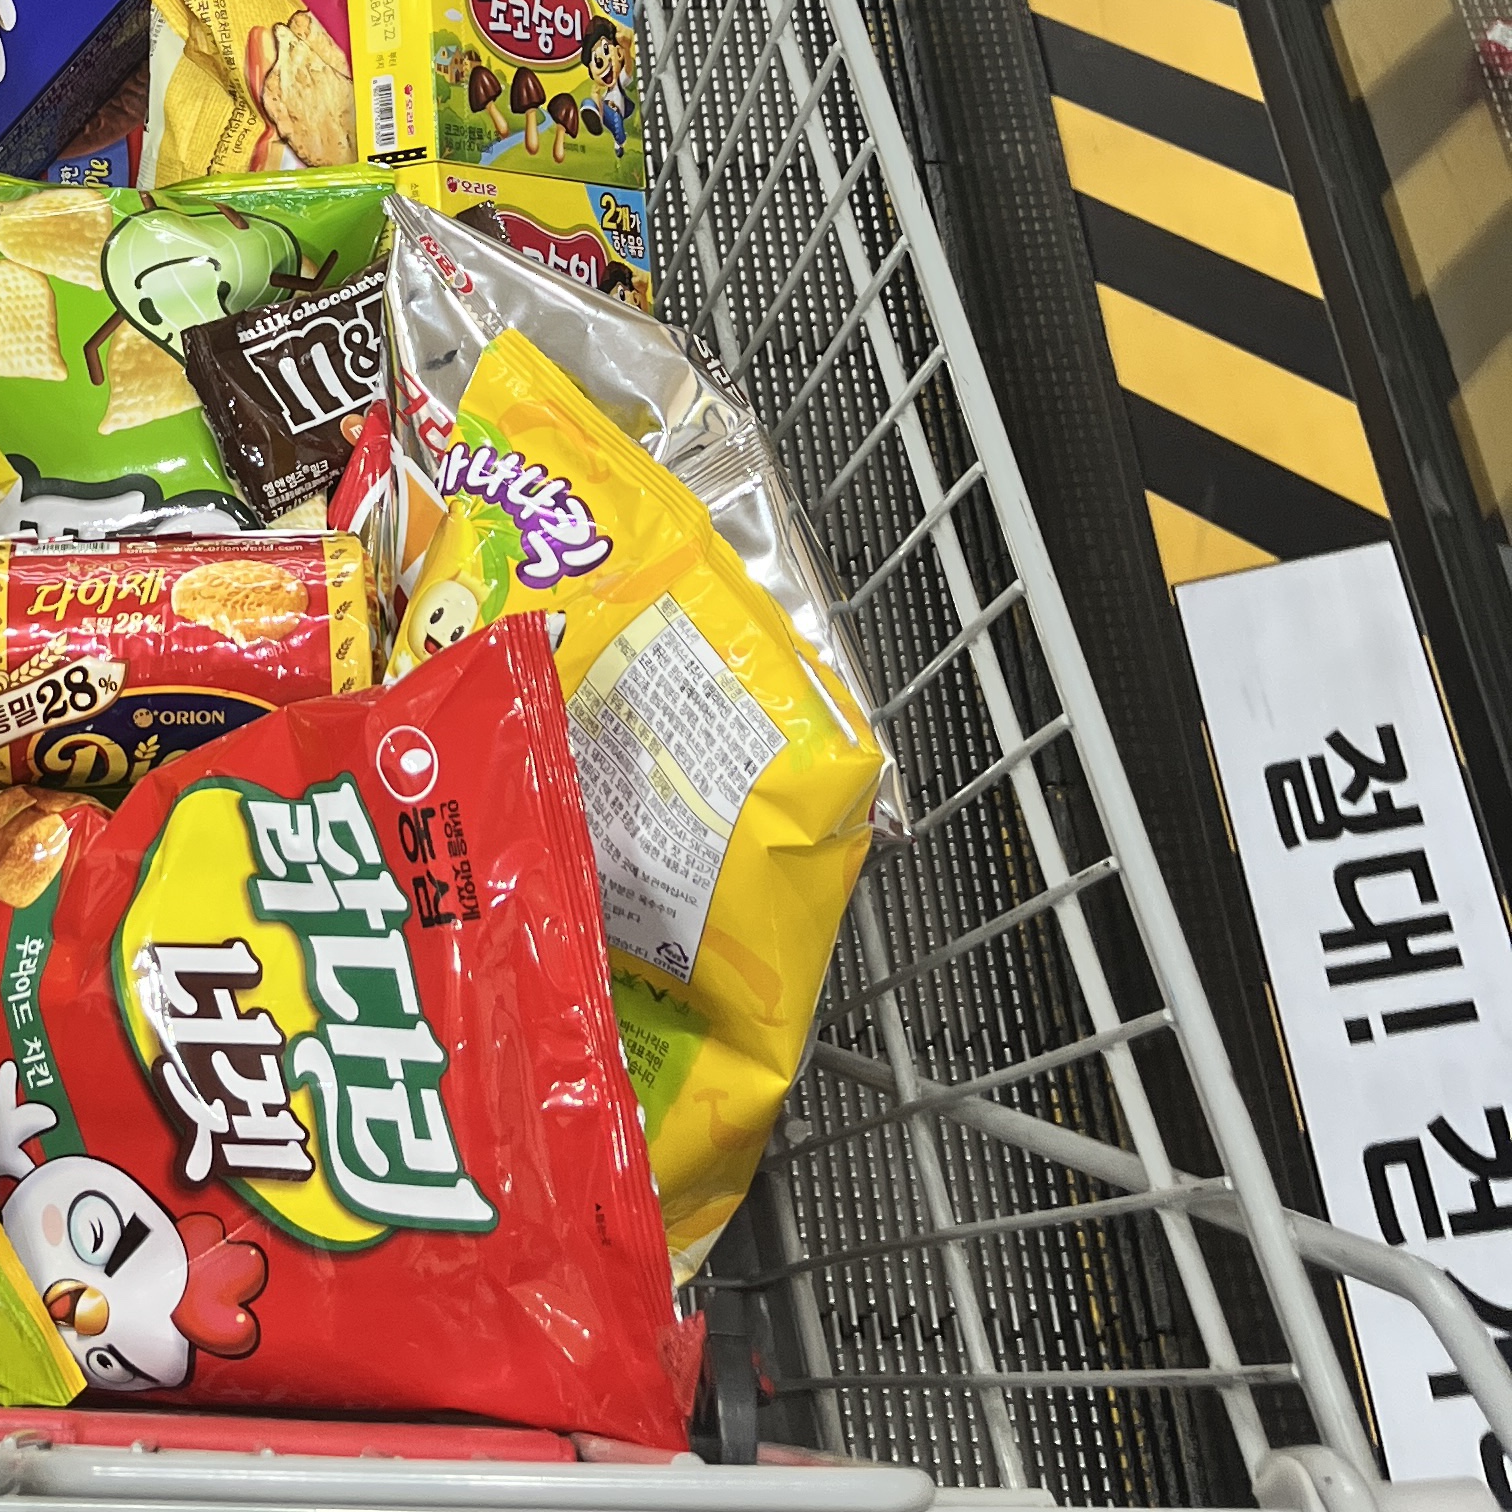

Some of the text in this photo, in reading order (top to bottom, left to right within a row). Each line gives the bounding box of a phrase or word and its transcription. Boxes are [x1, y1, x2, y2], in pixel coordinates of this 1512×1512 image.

[231, 126, 251, 155] kcal)
[404, 99, 416, 136] 오리온
[461, 179, 497, 197] 오리온
[600, 194, 642, 236] 2개가
[237, 269, 388, 344] milk chocolate
[172, 543, 304, 554] www.orionworld.com
[27, 568, 166, 622] 다이제
[155, 708, 226, 726] ORION
[398, 808, 458, 928] 농심
[438, 798, 482, 922] 인생을 맛있게
[1264, 721, 1479, 1047] 절대!
[638, 863, 701, 915] 보관하십시오
[652, 954, 687, 982] OTHER
[9, 936, 55, 1089] 후라이드 치킨
[248, 782, 496, 1222] 닭다리
[152, 940, 312, 1182] 너겟
[625, 1036, 665, 1072] 대표적인
